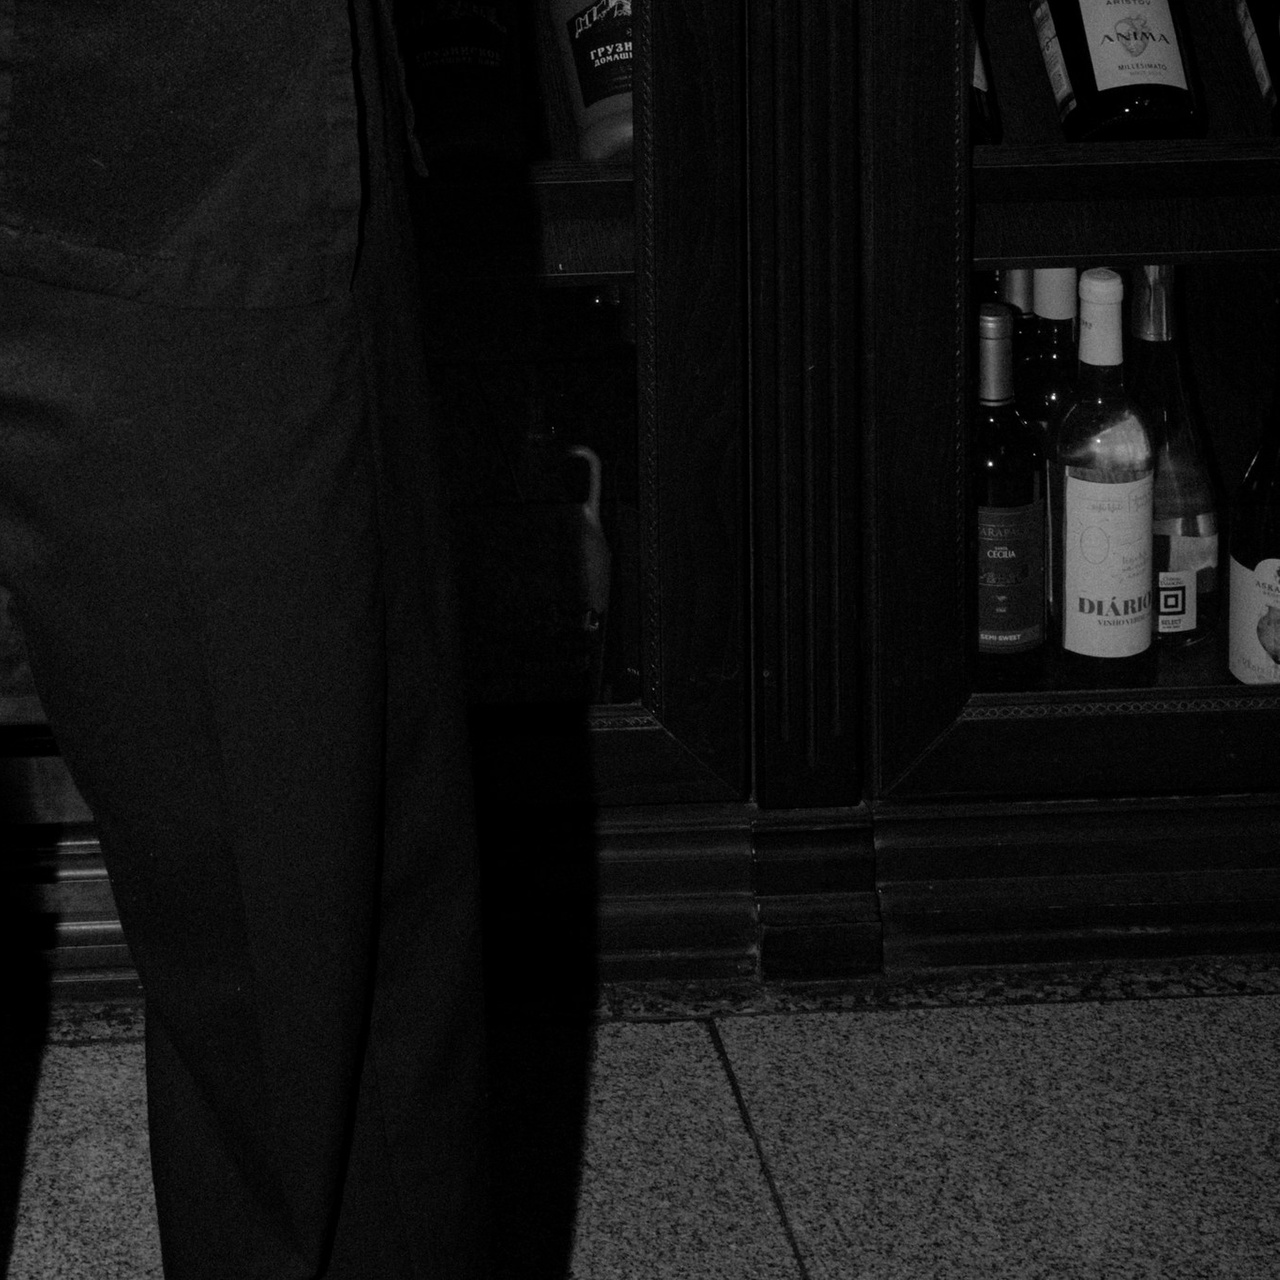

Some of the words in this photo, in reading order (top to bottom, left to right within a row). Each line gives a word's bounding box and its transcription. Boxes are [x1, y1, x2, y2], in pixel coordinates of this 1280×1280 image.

[1101, 32, 1170, 45] ANIMA
[589, 41, 632, 60] ГРУЗИ
[594, 52, 632, 67] ДОМАШ
[987, 550, 1016, 559] CECILIA
[1255, 580, 1280, 594] ASKA
[1079, 591, 1151, 616] DIÁRIO
[1098, 619, 1125, 627] VINHO
